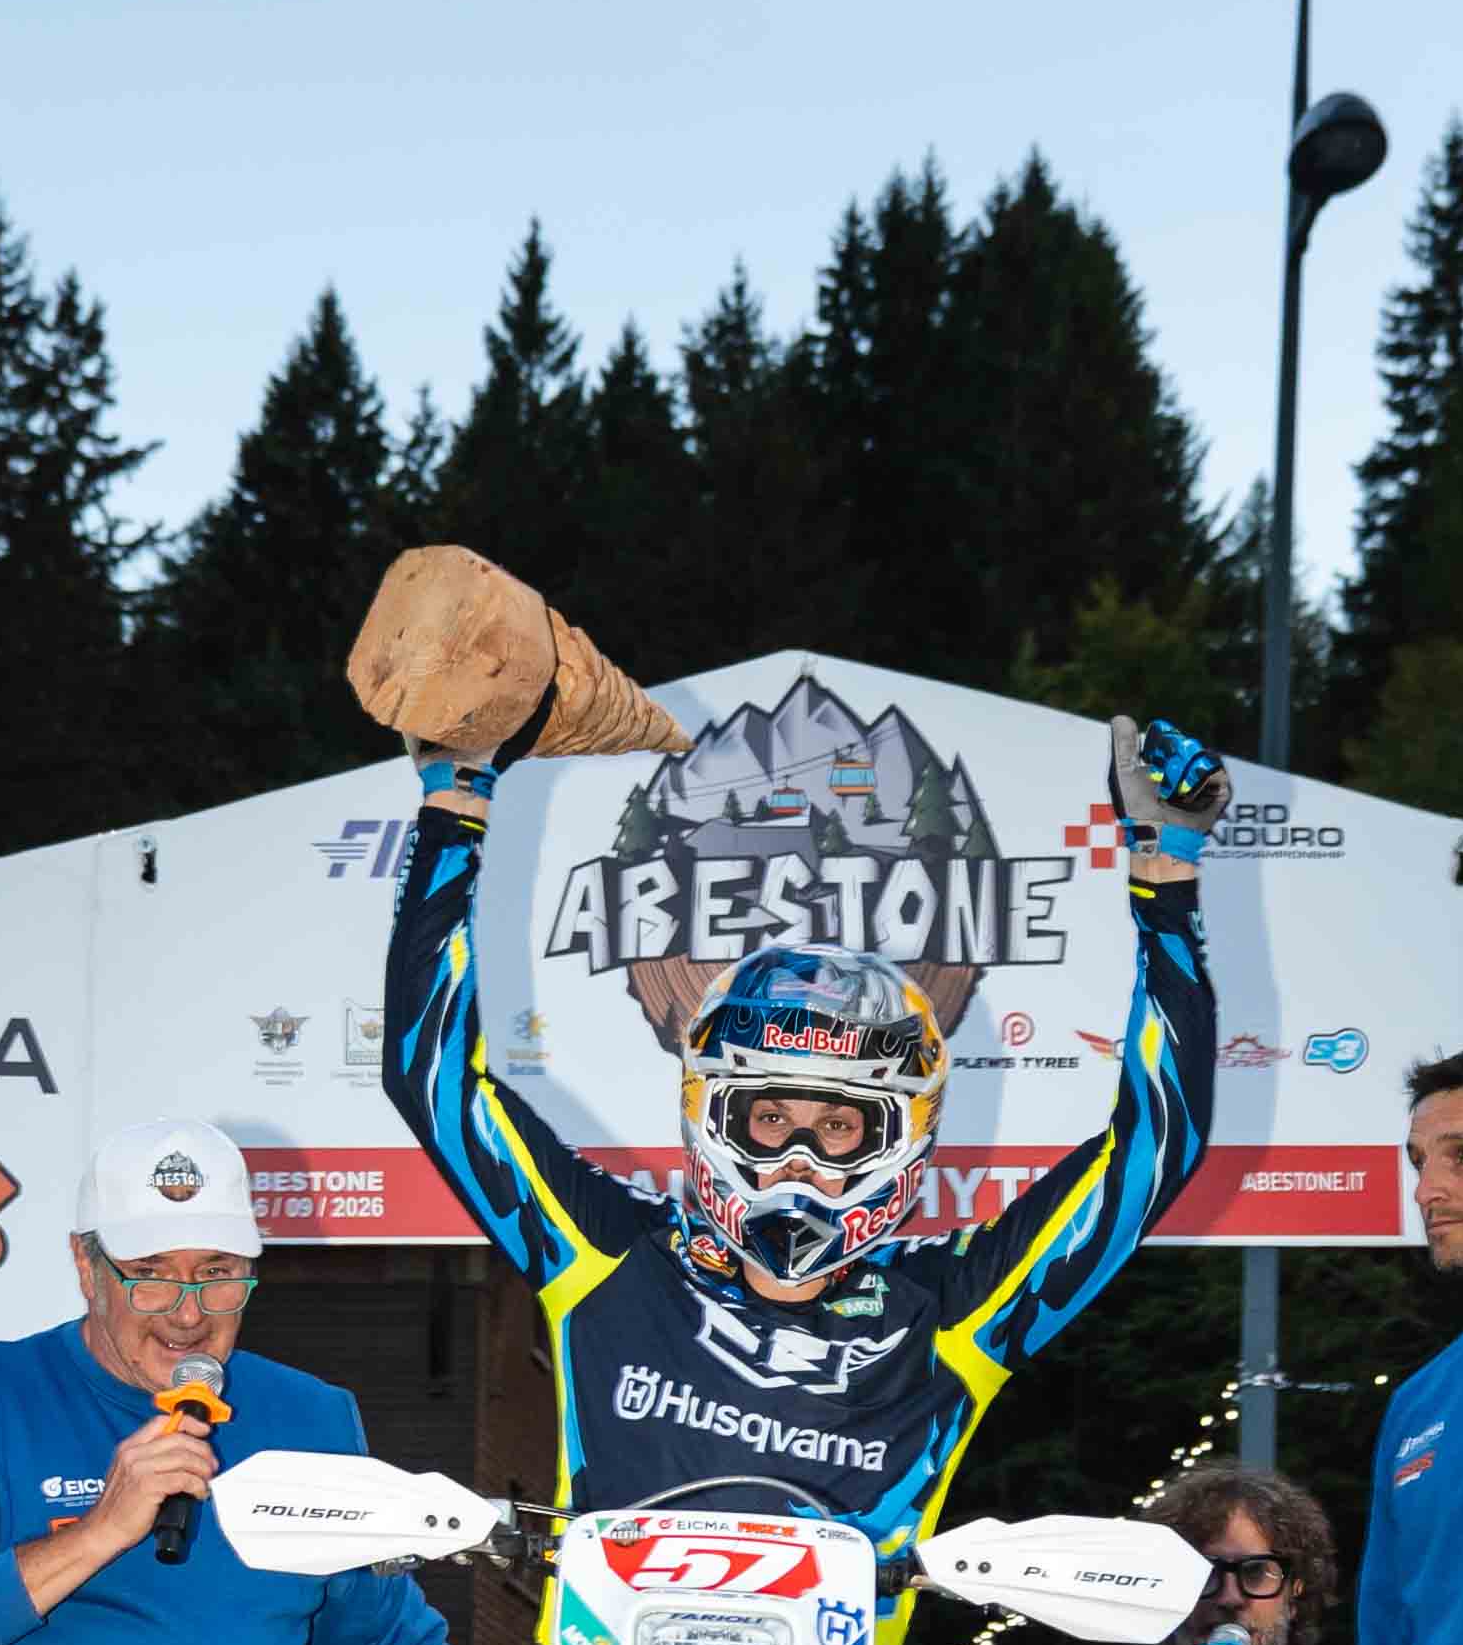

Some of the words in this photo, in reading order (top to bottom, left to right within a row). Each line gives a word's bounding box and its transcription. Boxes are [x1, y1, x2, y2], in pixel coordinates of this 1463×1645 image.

[1226, 804, 1289, 824] RD
[1212, 826, 1345, 848] NDURO
[310, 819, 416, 879] FI
[544, 852, 1075, 975] ABESTONE
[763, 1024, 811, 1050] Red
[812, 1028, 859, 1055] Bull
[953, 1057, 1017, 1069] PLEWS
[1021, 1056, 1079, 1068] TYRES
[250, 1171, 385, 1193] BESTONE
[918, 1166, 1050, 1219] HYT
[1240, 1171, 1367, 1192] ABESTONE.IT
[331, 1197, 385, 1219] 2026
[657, 1377, 888, 1472] Husqvarna
[66, 1479, 107, 1496] EIC
[677, 1520, 729, 1532] EICMA
[629, 1537, 809, 1593] 57
[669, 1613, 763, 1625] FARIOLI
